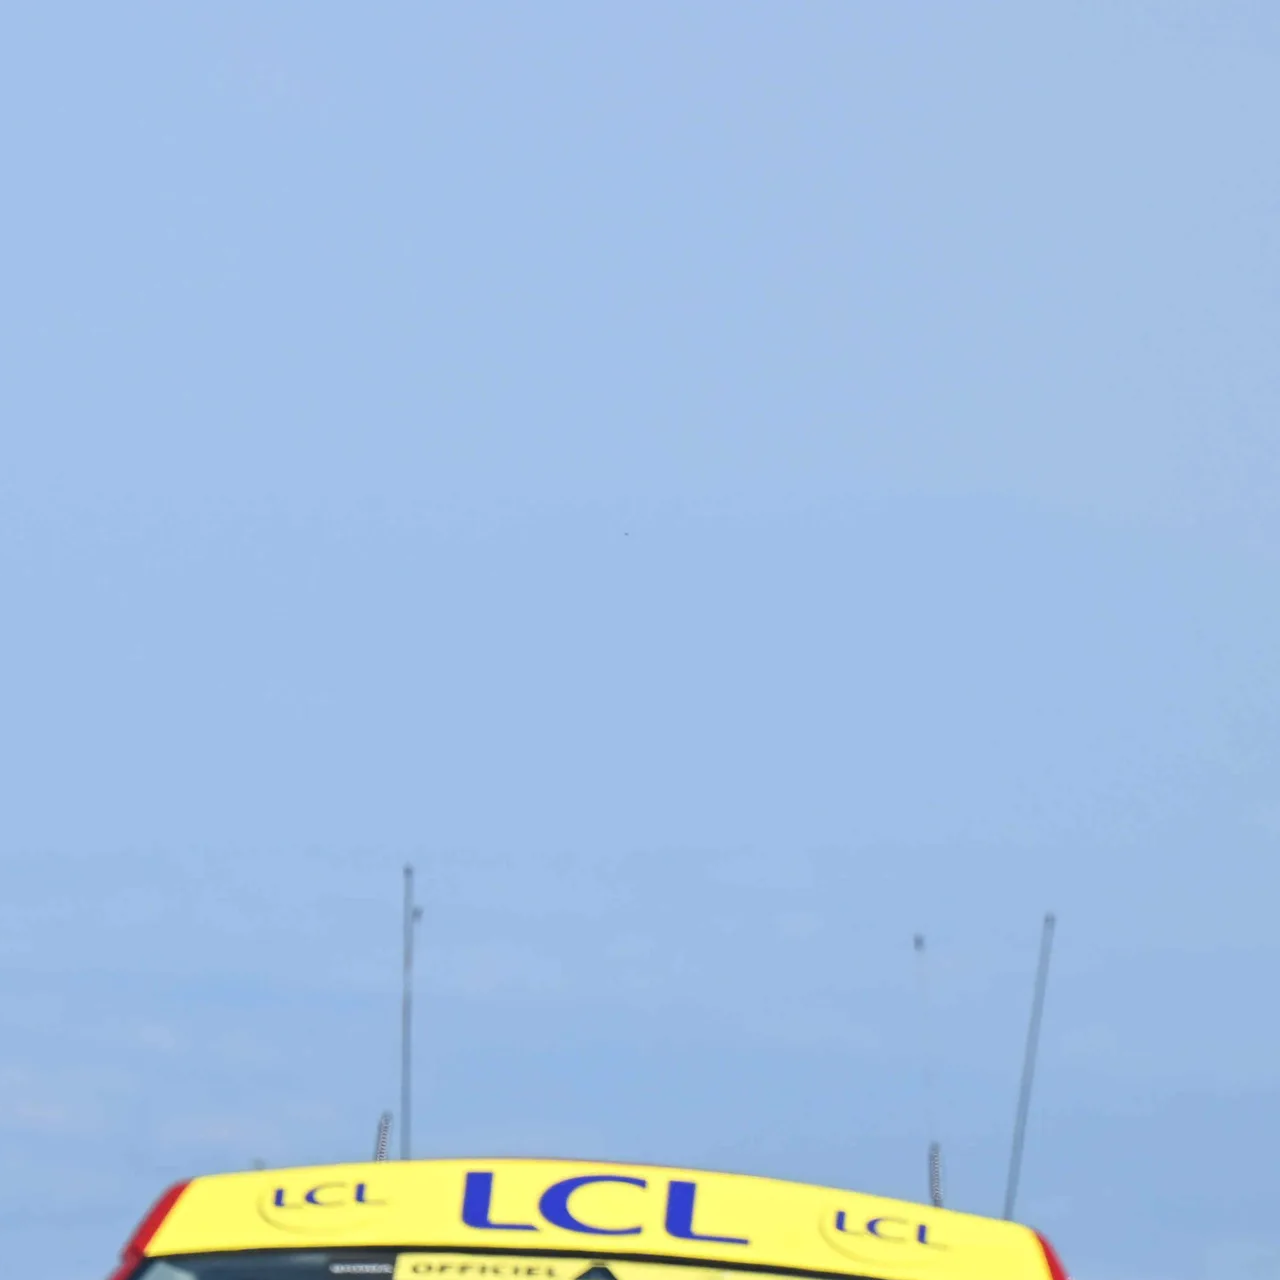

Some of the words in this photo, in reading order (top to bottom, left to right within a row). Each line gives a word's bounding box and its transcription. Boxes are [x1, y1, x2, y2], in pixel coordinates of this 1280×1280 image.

[272, 1180, 386, 1209] LCL
[461, 1171, 749, 1245] LCL
[833, 1208, 948, 1250] LCL
[411, 1260, 560, 1280] OFFICIEL
